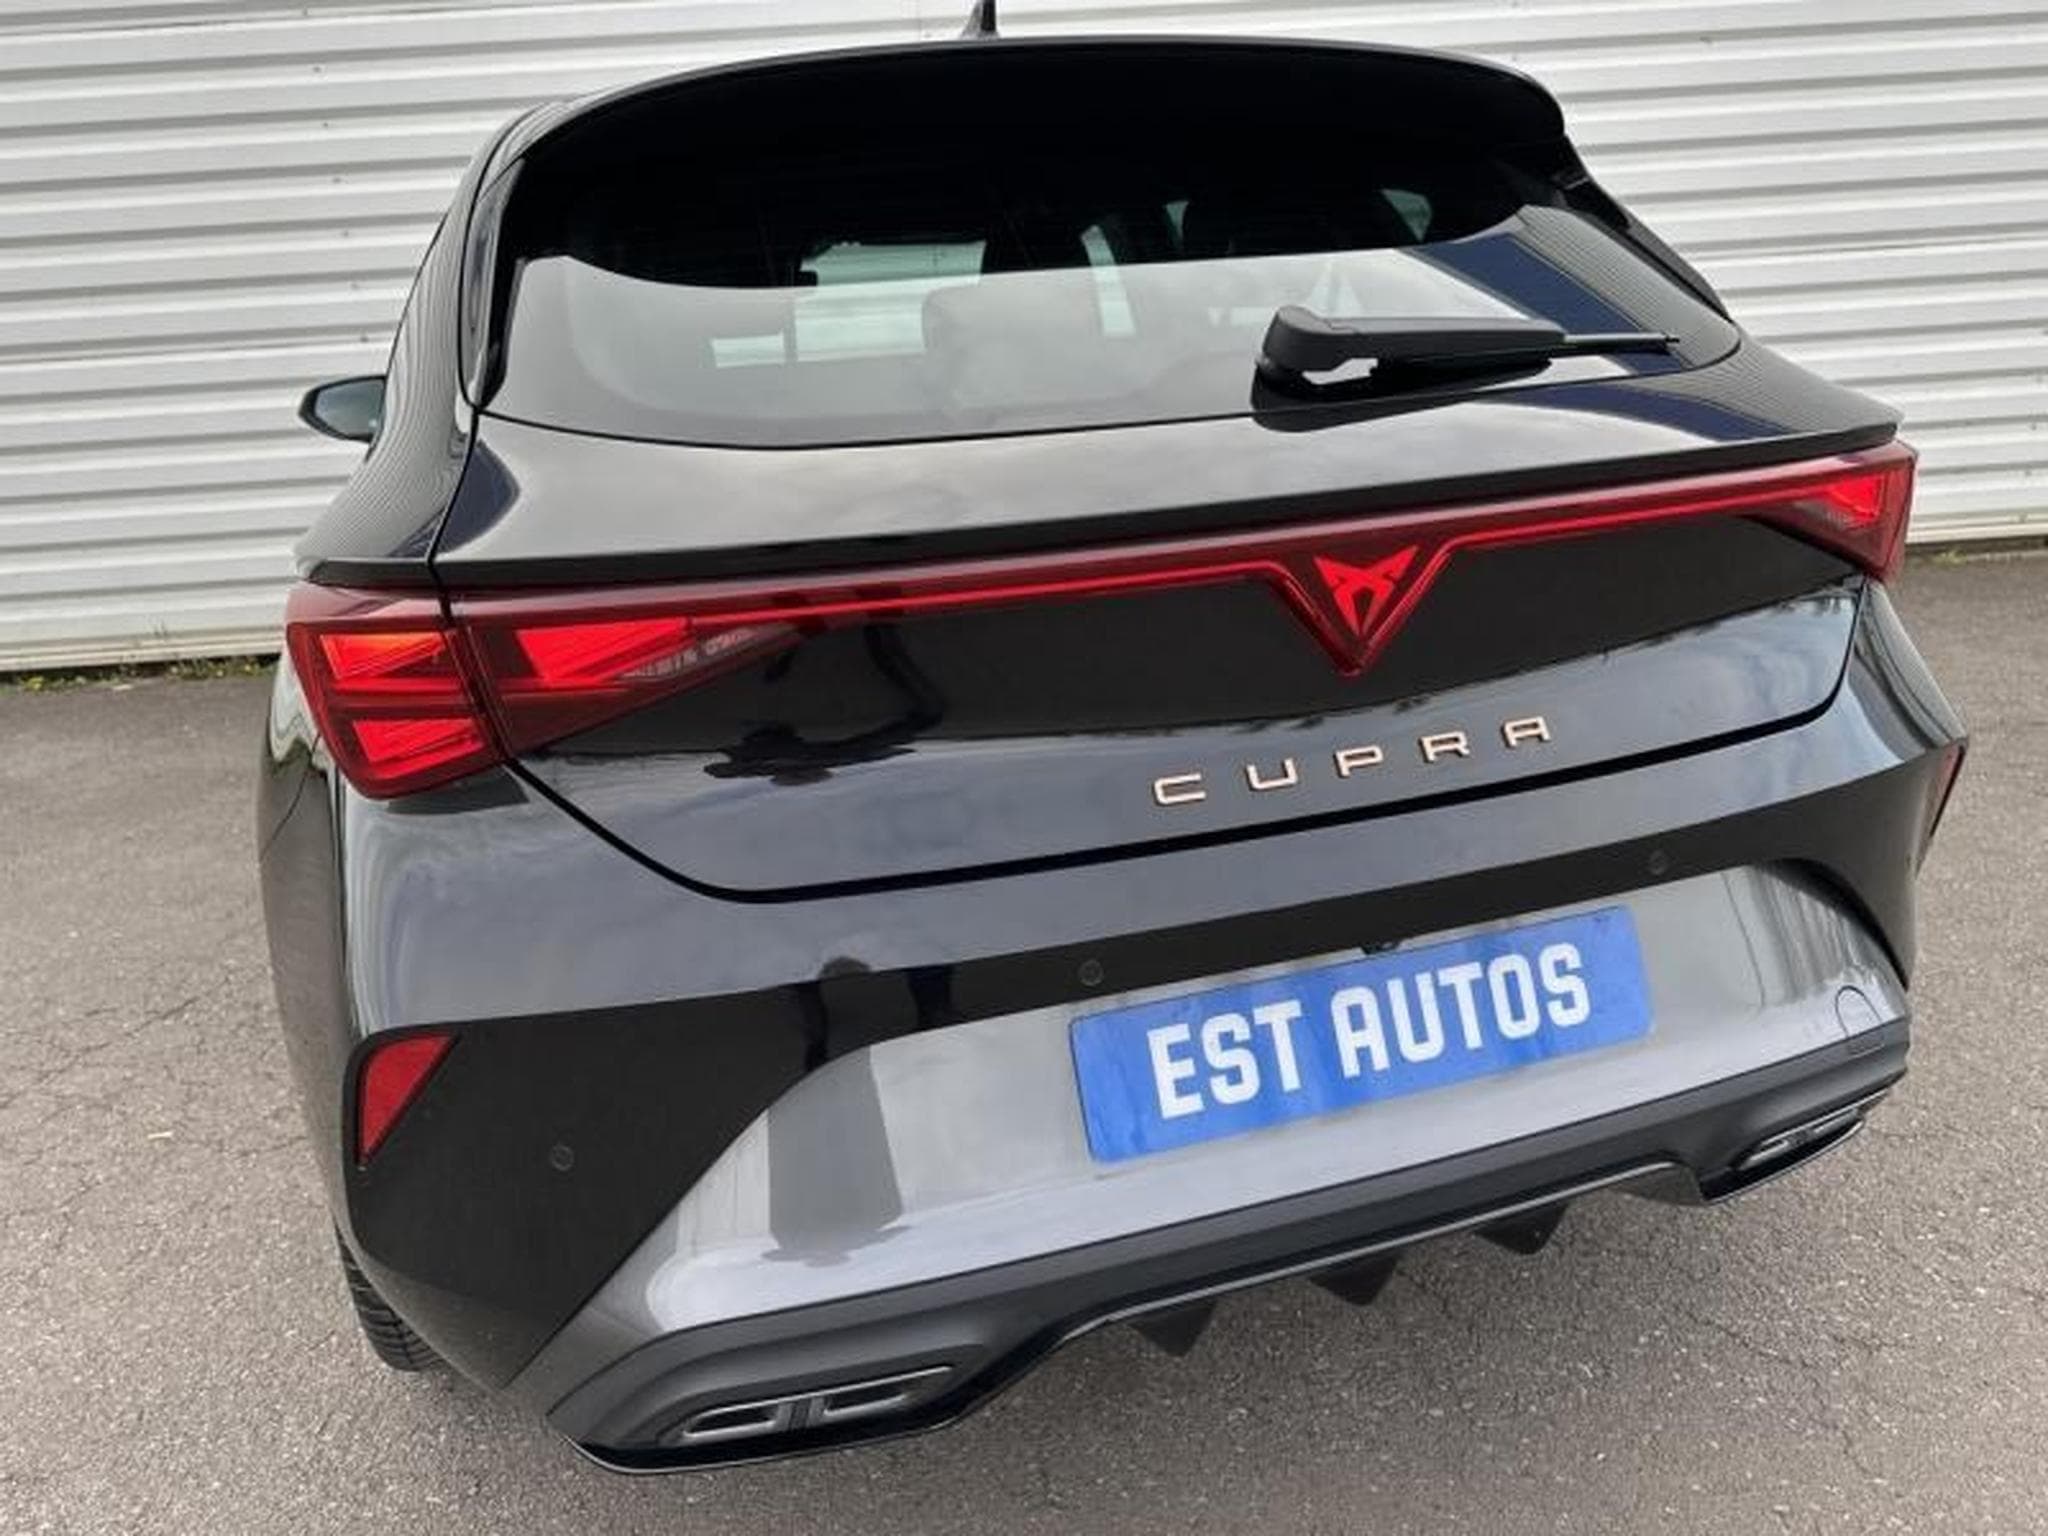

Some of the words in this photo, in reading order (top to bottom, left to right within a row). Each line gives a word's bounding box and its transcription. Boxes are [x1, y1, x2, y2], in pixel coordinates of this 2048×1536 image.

[1152, 715, 1553, 806] CUPRA
[1145, 1000, 1302, 1120] EST
[1330, 942, 1591, 1080] AUTOS
